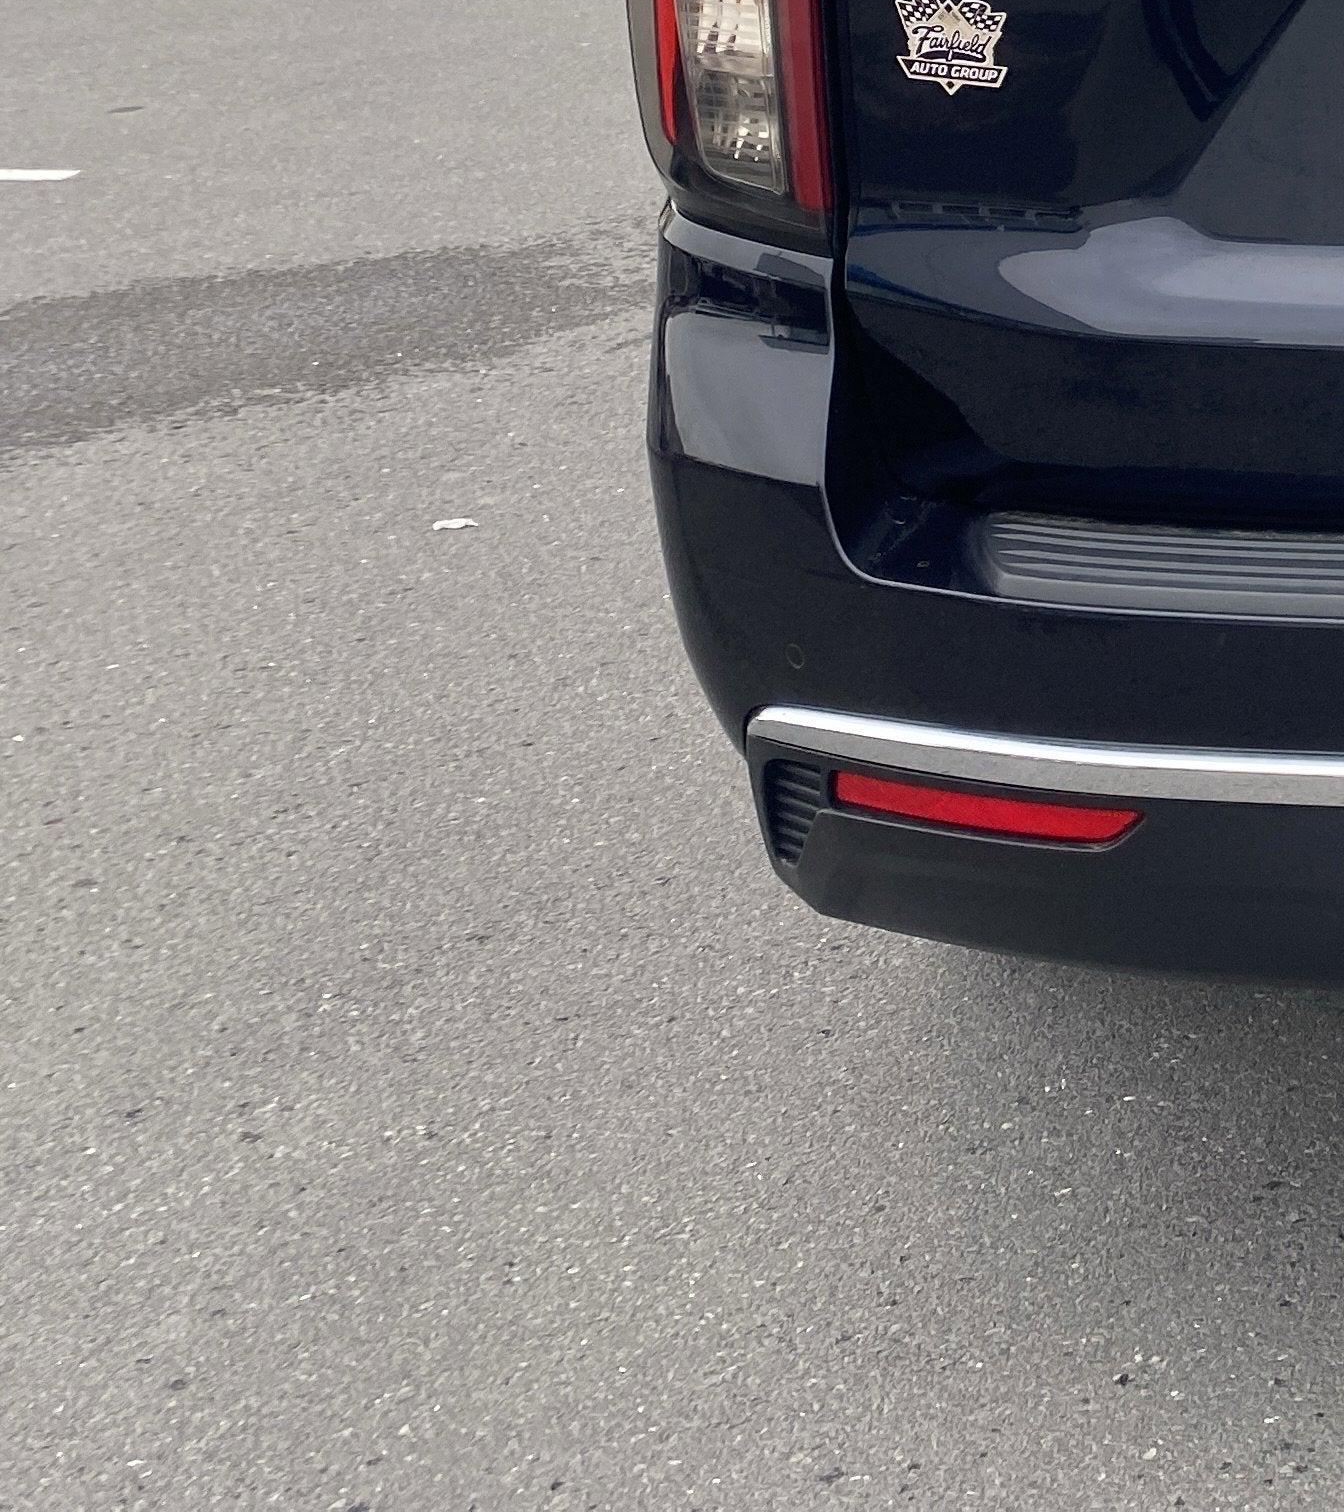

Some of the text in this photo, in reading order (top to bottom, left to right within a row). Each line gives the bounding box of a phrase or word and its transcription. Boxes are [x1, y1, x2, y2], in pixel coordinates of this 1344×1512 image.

[912, 25, 992, 55] Fairfield
[911, 62, 998, 81] AUTO GROUP
